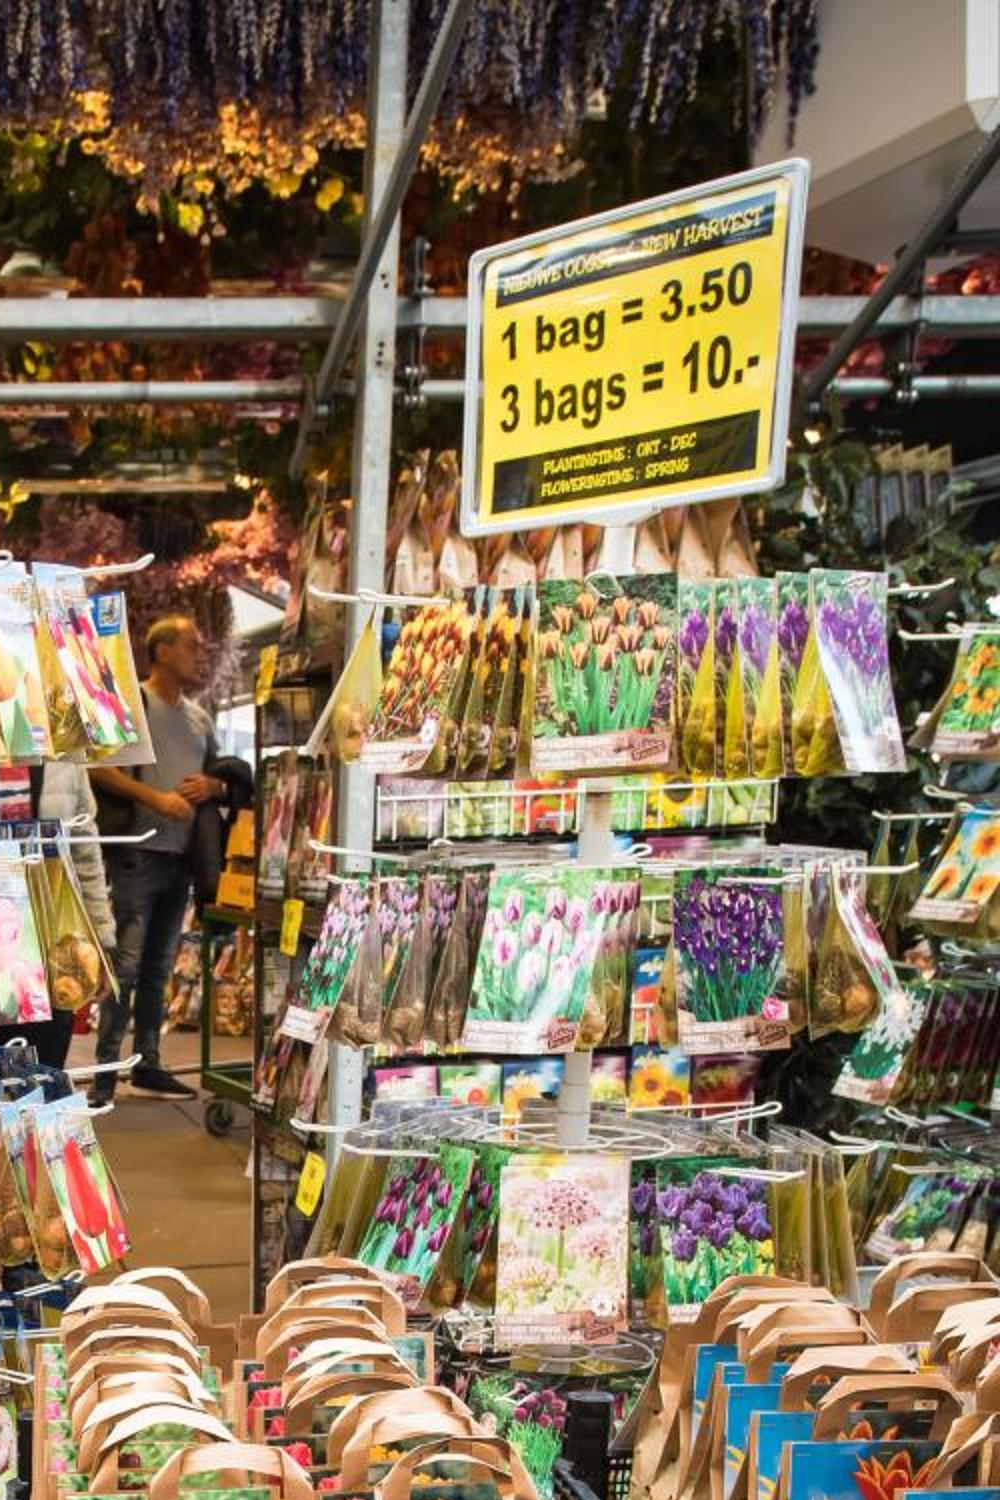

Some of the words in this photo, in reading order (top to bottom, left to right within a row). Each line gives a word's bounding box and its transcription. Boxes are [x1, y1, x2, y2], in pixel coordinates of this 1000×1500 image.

[502, 267, 562, 296] NIEUWE
[642, 230, 682, 255] NEW
[683, 206, 764, 247] HARVEST
[501, 320, 519, 362] 1
[535, 308, 606, 355] bag
[660, 260, 753, 324] 3.50
[500, 383, 520, 434] 3
[534, 370, 627, 429] bags
[681, 334, 761, 395] 10.-
[645, 457, 689, 480] SPRING
